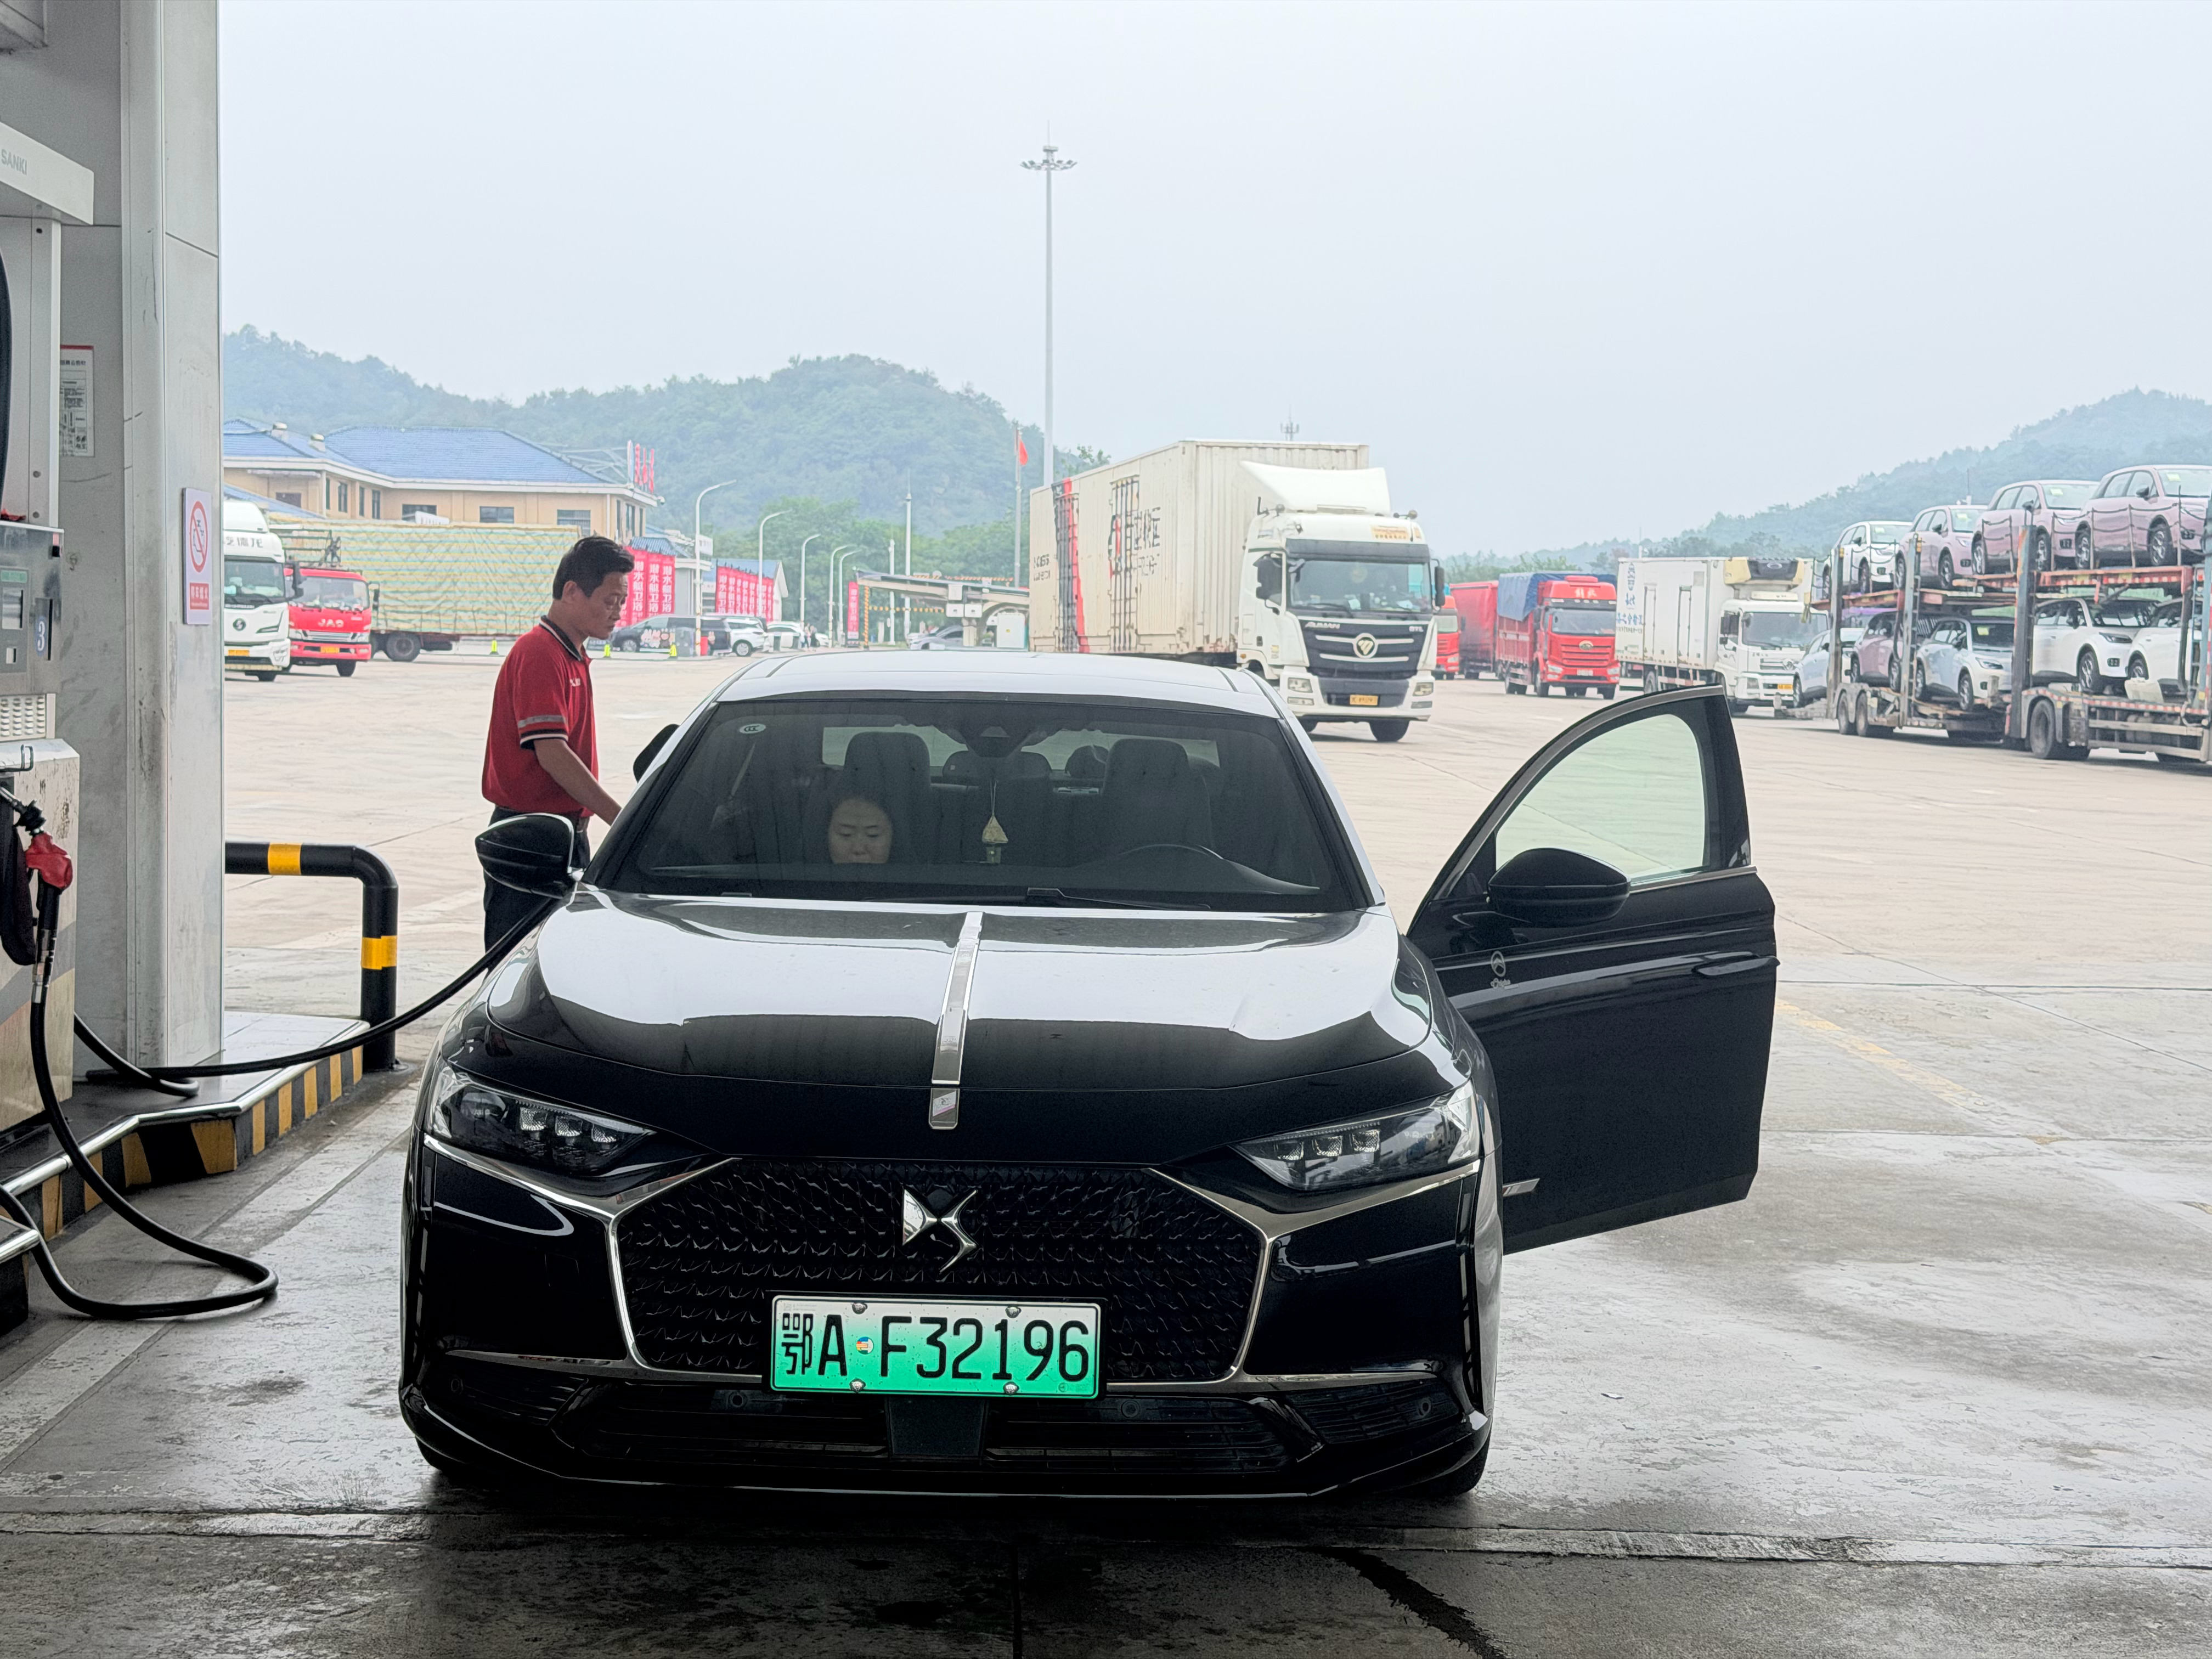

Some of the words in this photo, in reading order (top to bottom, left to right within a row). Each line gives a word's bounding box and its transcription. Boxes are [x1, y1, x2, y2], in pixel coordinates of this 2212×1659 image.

[1, 149, 27, 176] SANKI
[633, 561, 645, 612] 潜水艇卫浴
[648, 563, 659, 612] 潜水艇卫浴
[662, 566, 673, 613] 潜水艇卫浴
[37, 620, 46, 652] 3
